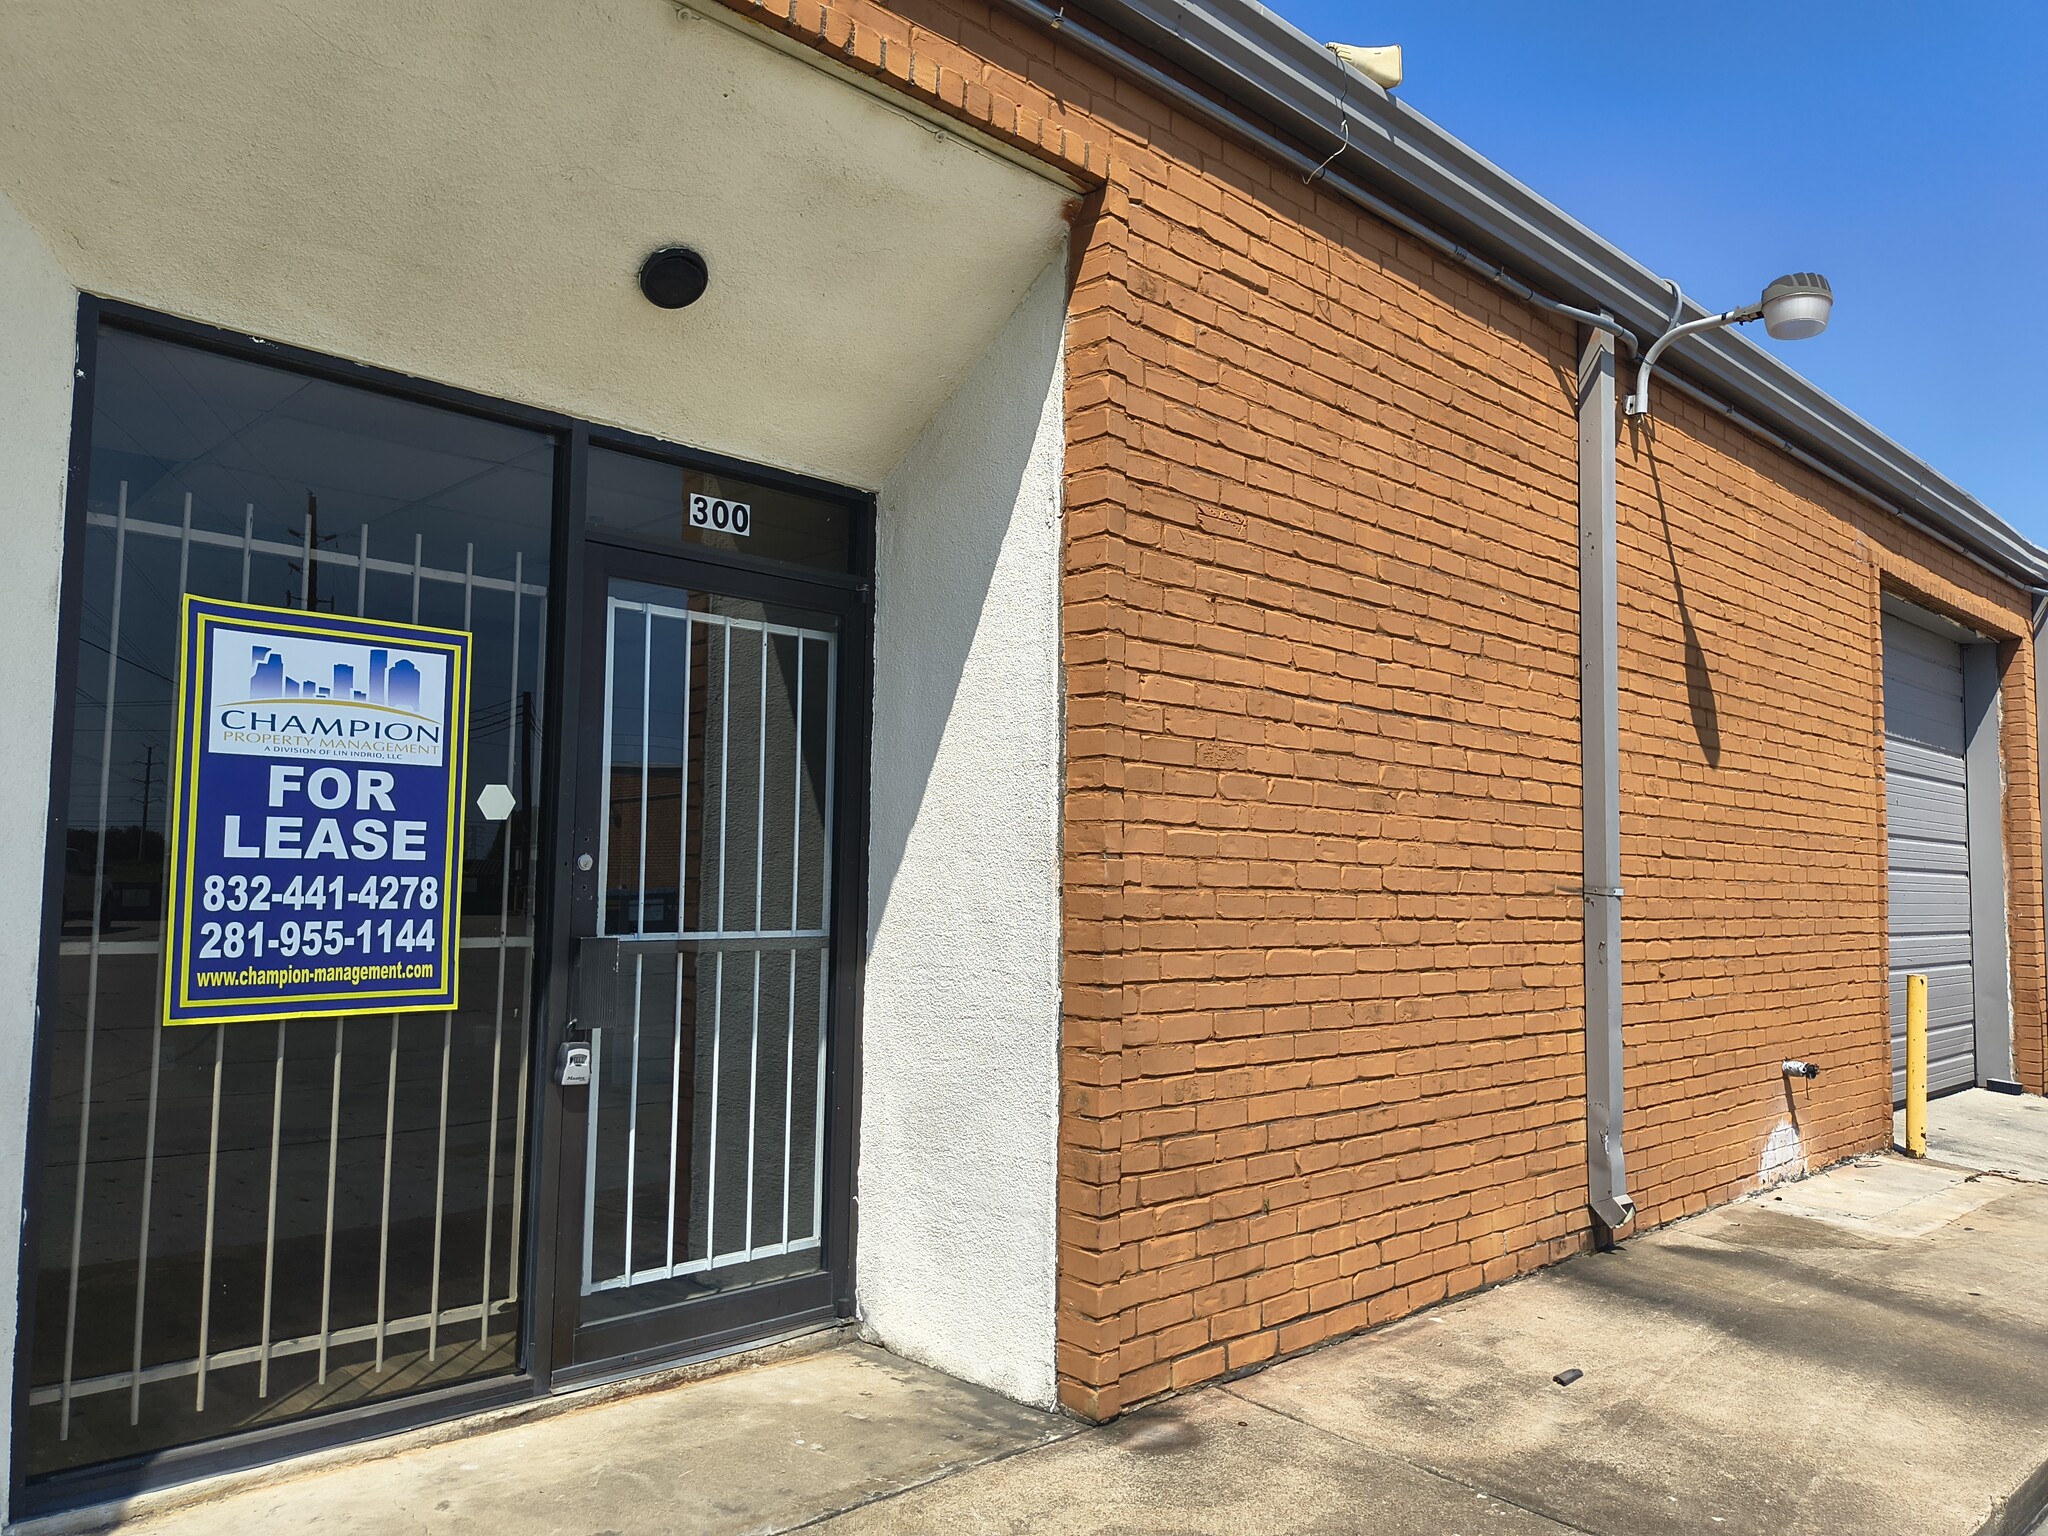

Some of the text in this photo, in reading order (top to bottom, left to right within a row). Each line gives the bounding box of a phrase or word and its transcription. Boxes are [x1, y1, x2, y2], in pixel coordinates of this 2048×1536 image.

[692, 496, 749, 533] 300
[220, 709, 440, 744] CHAMPION
[223, 731, 440, 755] PROPERTY MANAGEMENT
[273, 746, 317, 755] DIVISION
[350, 751, 385, 760] INDRIO,
[268, 765, 396, 812] FOR
[223, 815, 428, 861] LEASE
[202, 874, 439, 912] 832-441-4278
[198, 918, 436, 959] 281-955-1144
[196, 961, 434, 989] www.champion-management.com
